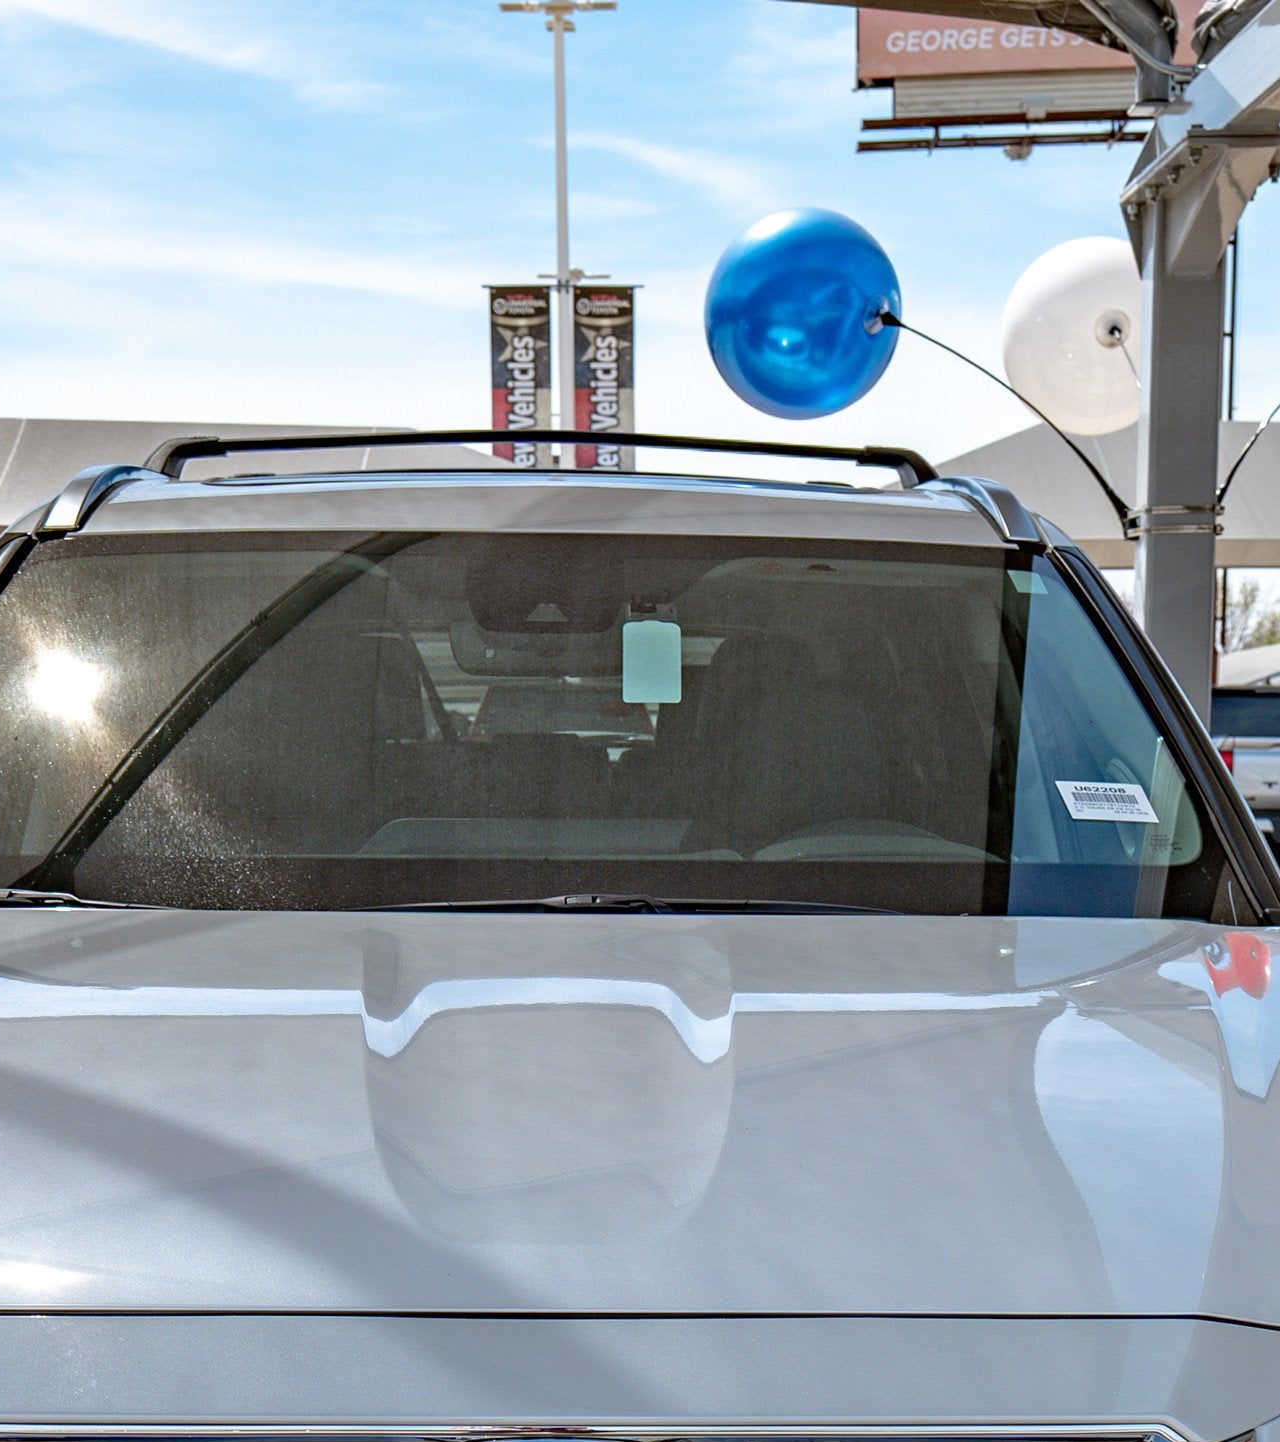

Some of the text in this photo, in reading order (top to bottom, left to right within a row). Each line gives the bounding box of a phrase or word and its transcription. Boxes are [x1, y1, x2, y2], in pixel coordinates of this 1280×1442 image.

[886, 27, 994, 53] GEORGE
[999, 25, 1066, 48] GETS
[506, 334, 536, 430] Vehicles
[589, 334, 619, 431] Vehicles
